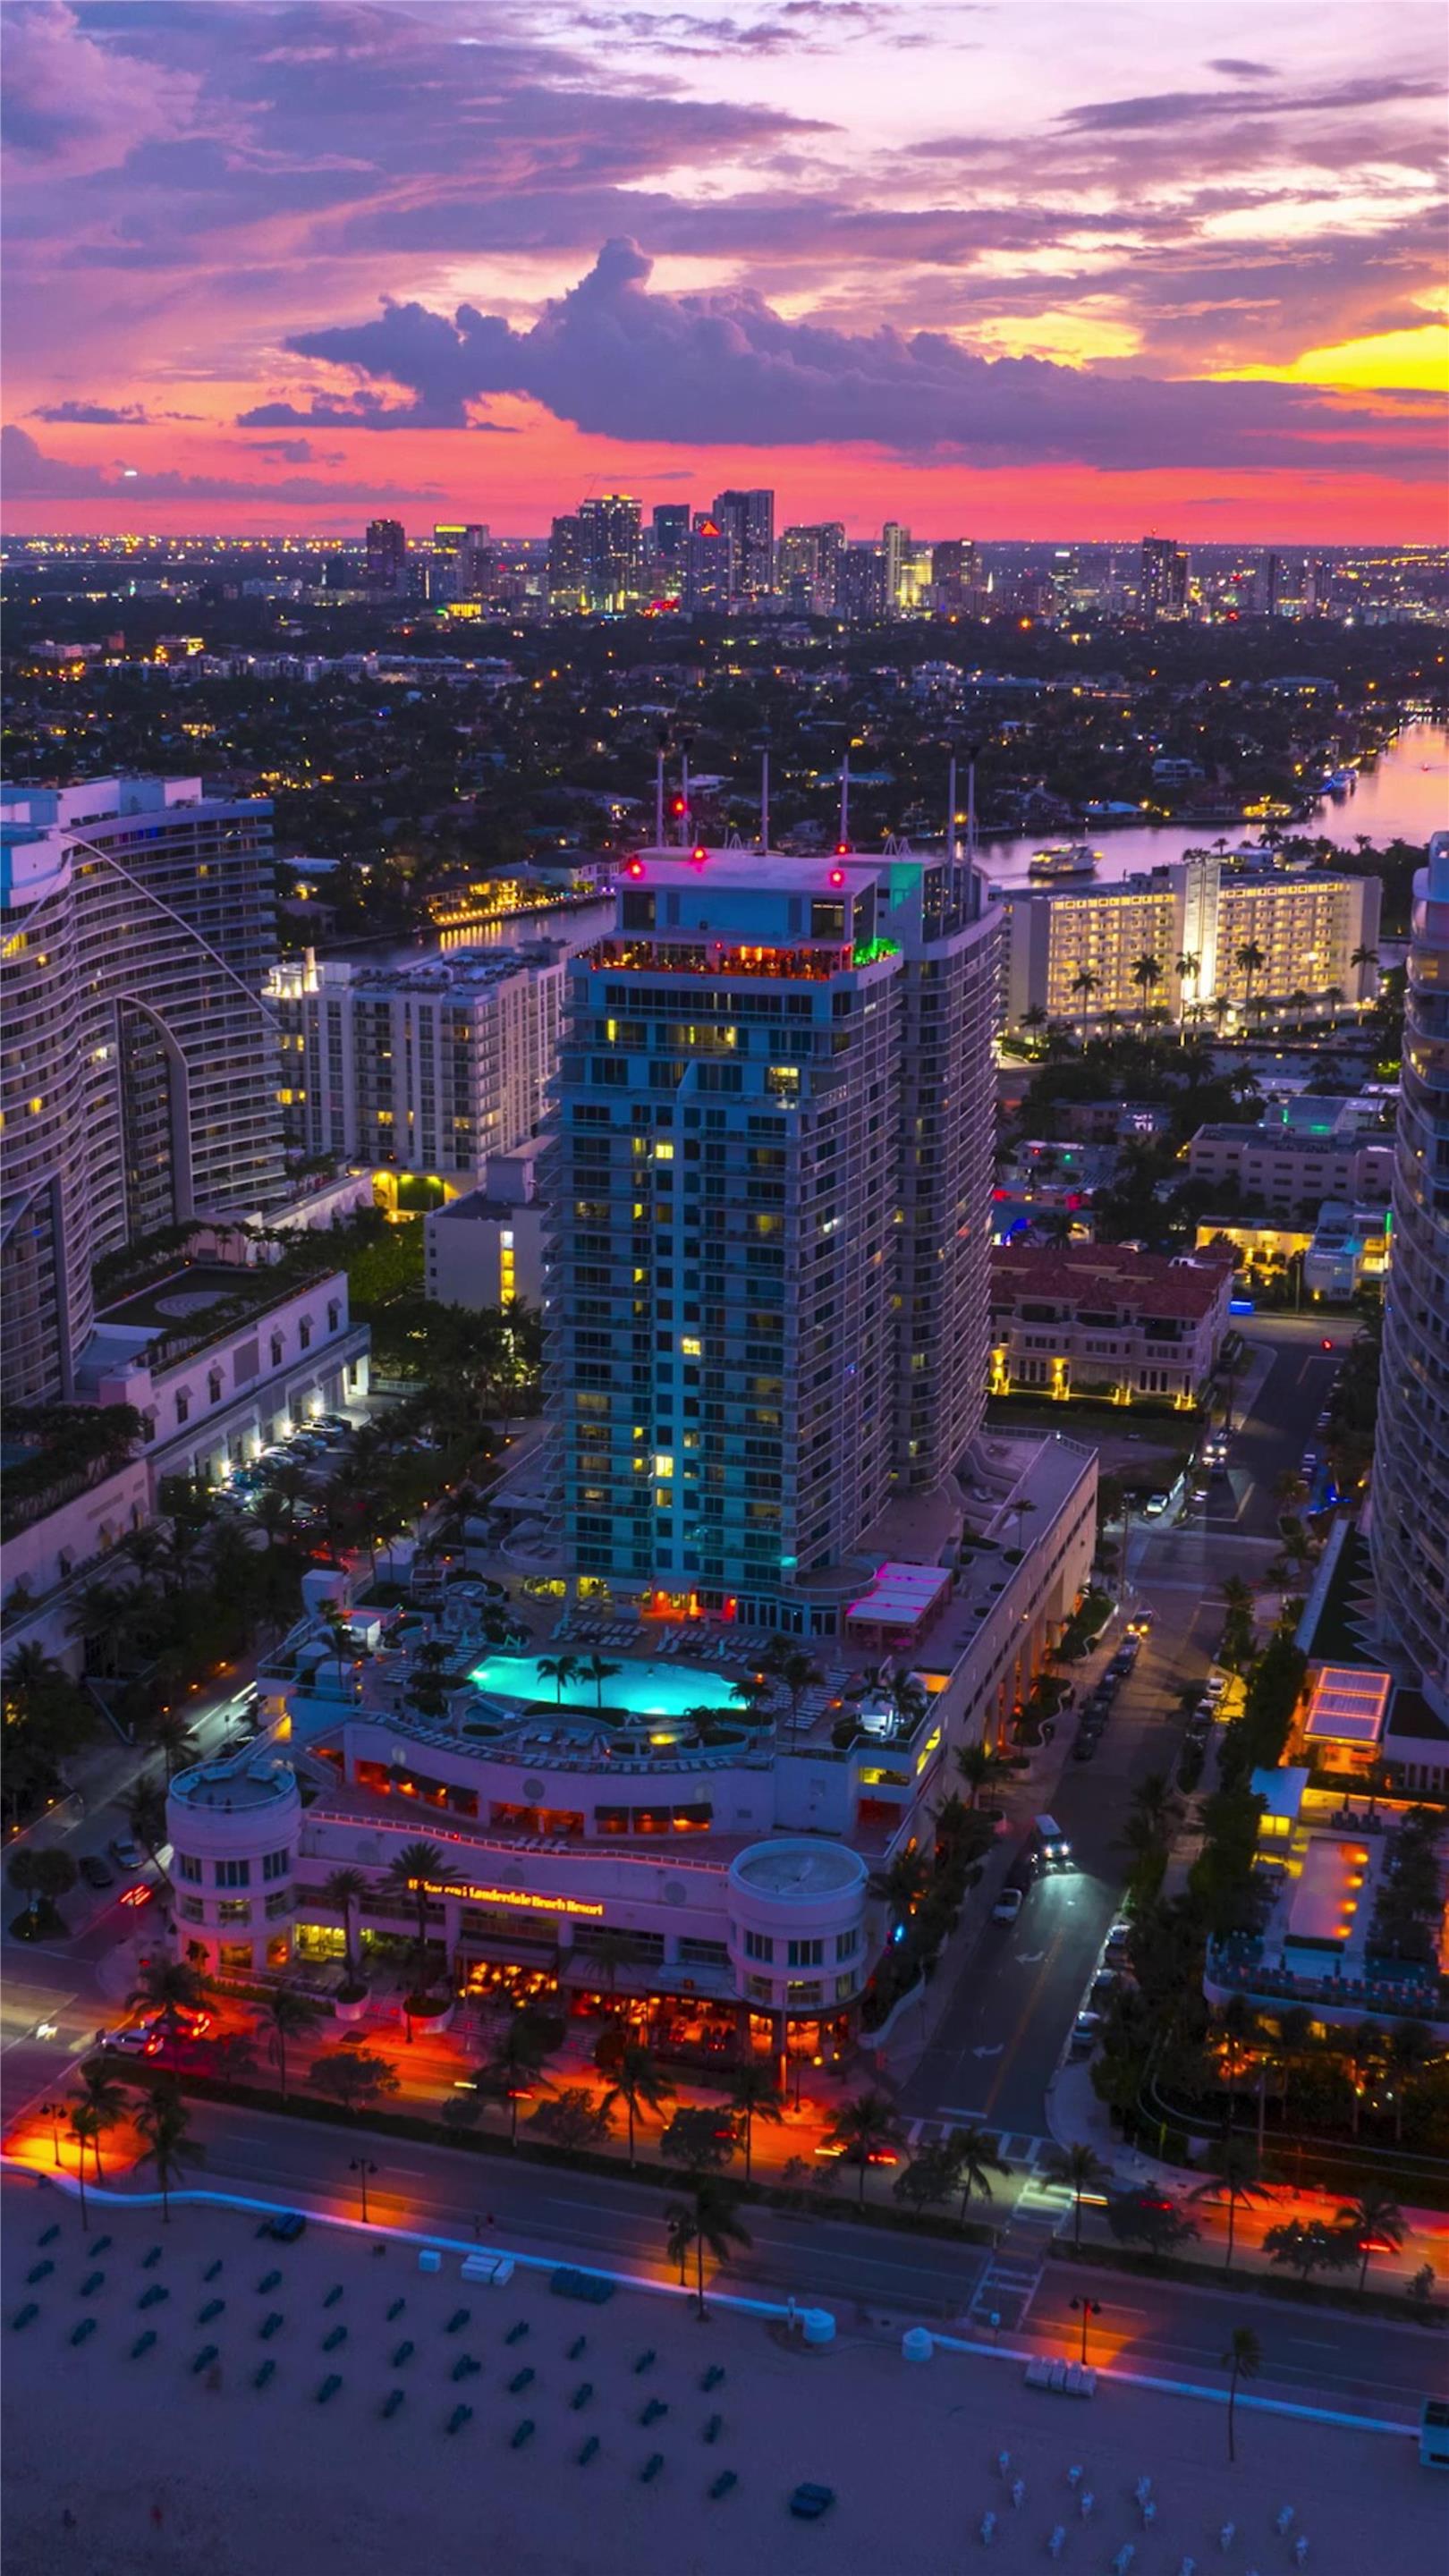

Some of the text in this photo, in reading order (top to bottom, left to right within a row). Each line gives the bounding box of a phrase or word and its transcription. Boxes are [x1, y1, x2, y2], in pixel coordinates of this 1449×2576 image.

[470, 1886, 531, 1905] Lauderdale
[532, 1895, 565, 1911] Beach
[567, 1900, 603, 1916] Resort
